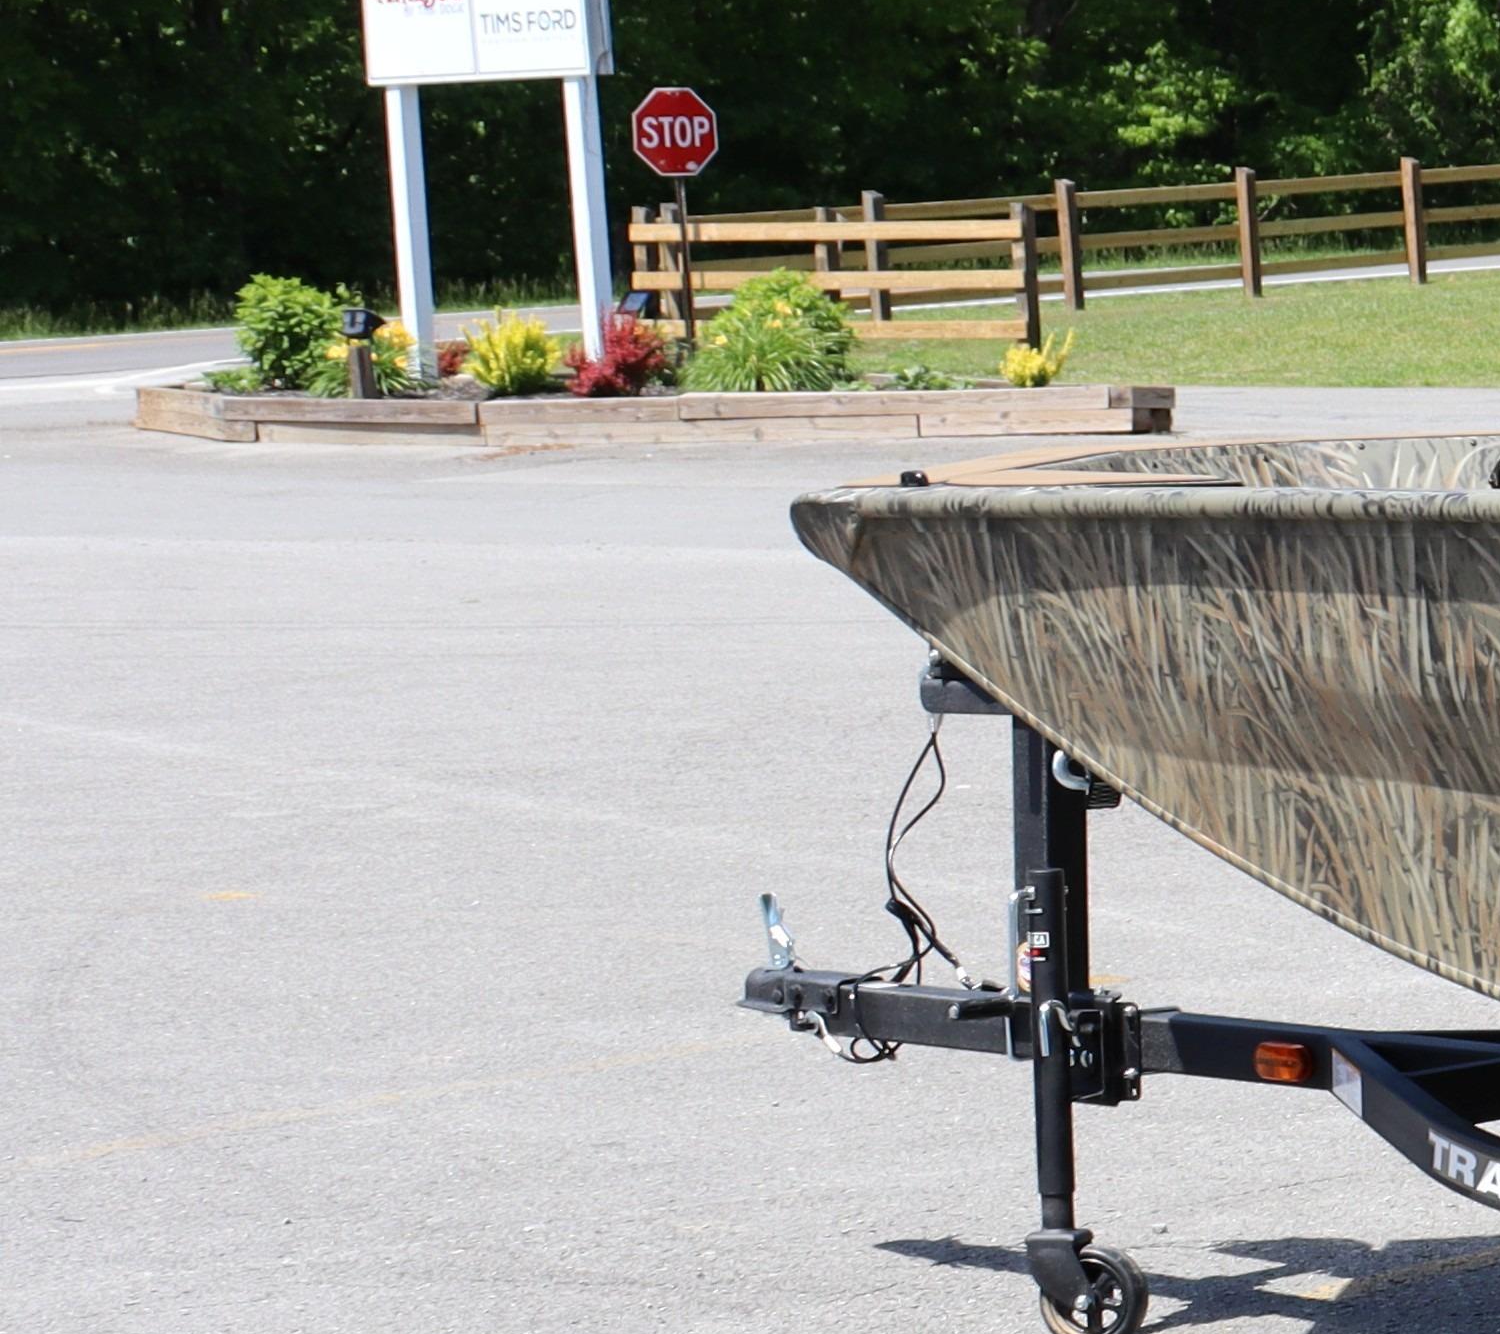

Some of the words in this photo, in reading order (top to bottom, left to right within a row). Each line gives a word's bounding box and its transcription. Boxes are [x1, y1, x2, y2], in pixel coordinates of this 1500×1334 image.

[480, 11, 522, 35] TIMS
[527, 9, 577, 32] FORD
[641, 115, 710, 149] STOP
